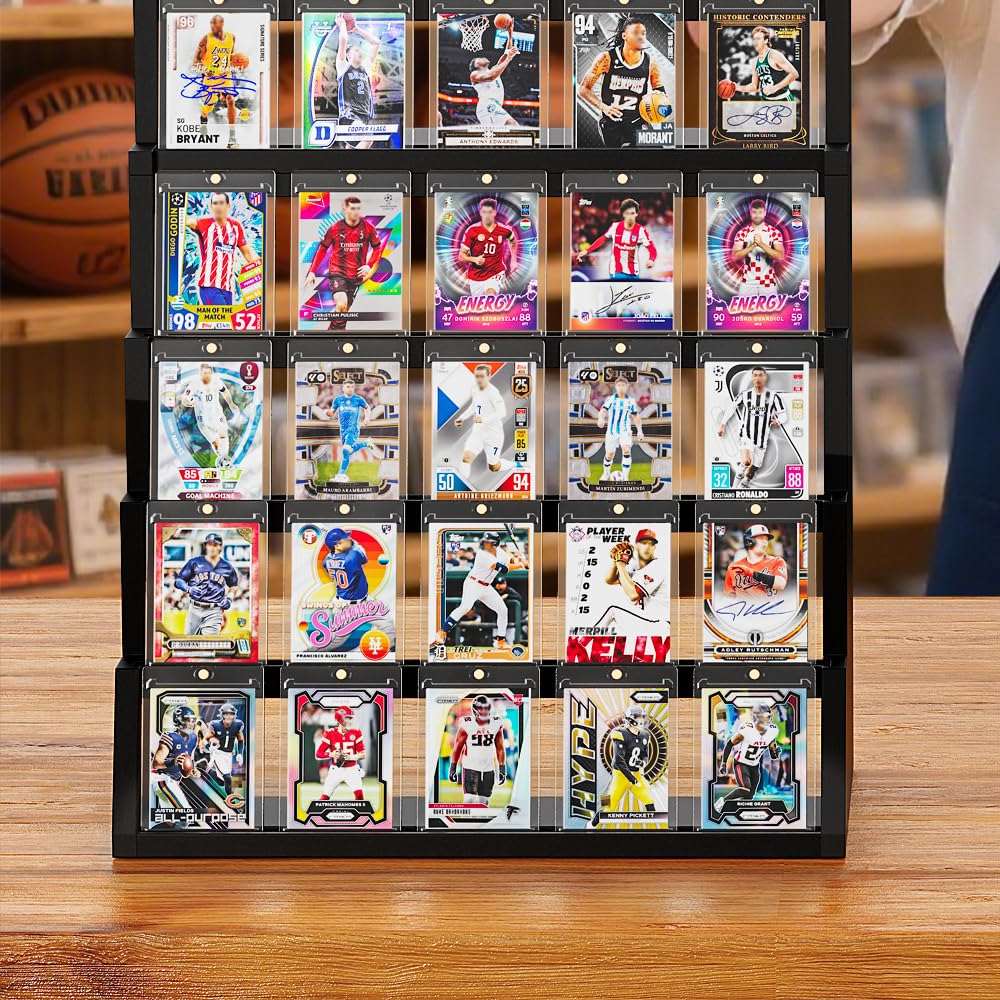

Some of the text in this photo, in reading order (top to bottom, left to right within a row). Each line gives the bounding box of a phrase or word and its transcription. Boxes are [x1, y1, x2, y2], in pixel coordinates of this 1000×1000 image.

[575, 15, 595, 35] 94
[212, 55, 229, 68] 24
[356, 81, 365, 95] 2
[177, 124, 200, 133] KOBE
[177, 134, 220, 143] BRYANT
[637, 132, 673, 144] MORANT
[484, 243, 496, 255] 10
[457, 294, 516, 313] ENERGY
[728, 294, 788, 314] ENERGY
[174, 313, 195, 330] 98
[235, 313, 257, 330] 52
[442, 313, 453, 322] 47
[519, 313, 531, 322] 88
[713, 313, 725, 322] 90
[791, 313, 803, 322] 59
[333, 369, 363, 382] SELECT
[515, 378, 529, 392] 25
[477, 405, 482, 415] 7
[184, 469, 198, 479] 85
[713, 473, 728, 488] 32
[788, 473, 801, 488] 88
[438, 474, 454, 490] 50
[513, 474, 529, 491] 94
[589, 546, 595, 554] 2
[587, 558, 598, 566] 15
[585, 570, 591, 578] 6
[583, 582, 589, 590] 0
[581, 594, 587, 602] 2
[579, 606, 590, 614] 15
[310, 600, 390, 648] Summer
[569, 626, 617, 636] MERRILL
[566, 636, 670, 663] KELLY
[333, 741, 354, 757] 15
[570, 693, 597, 818] HYPE
[629, 747, 641, 768] 8
